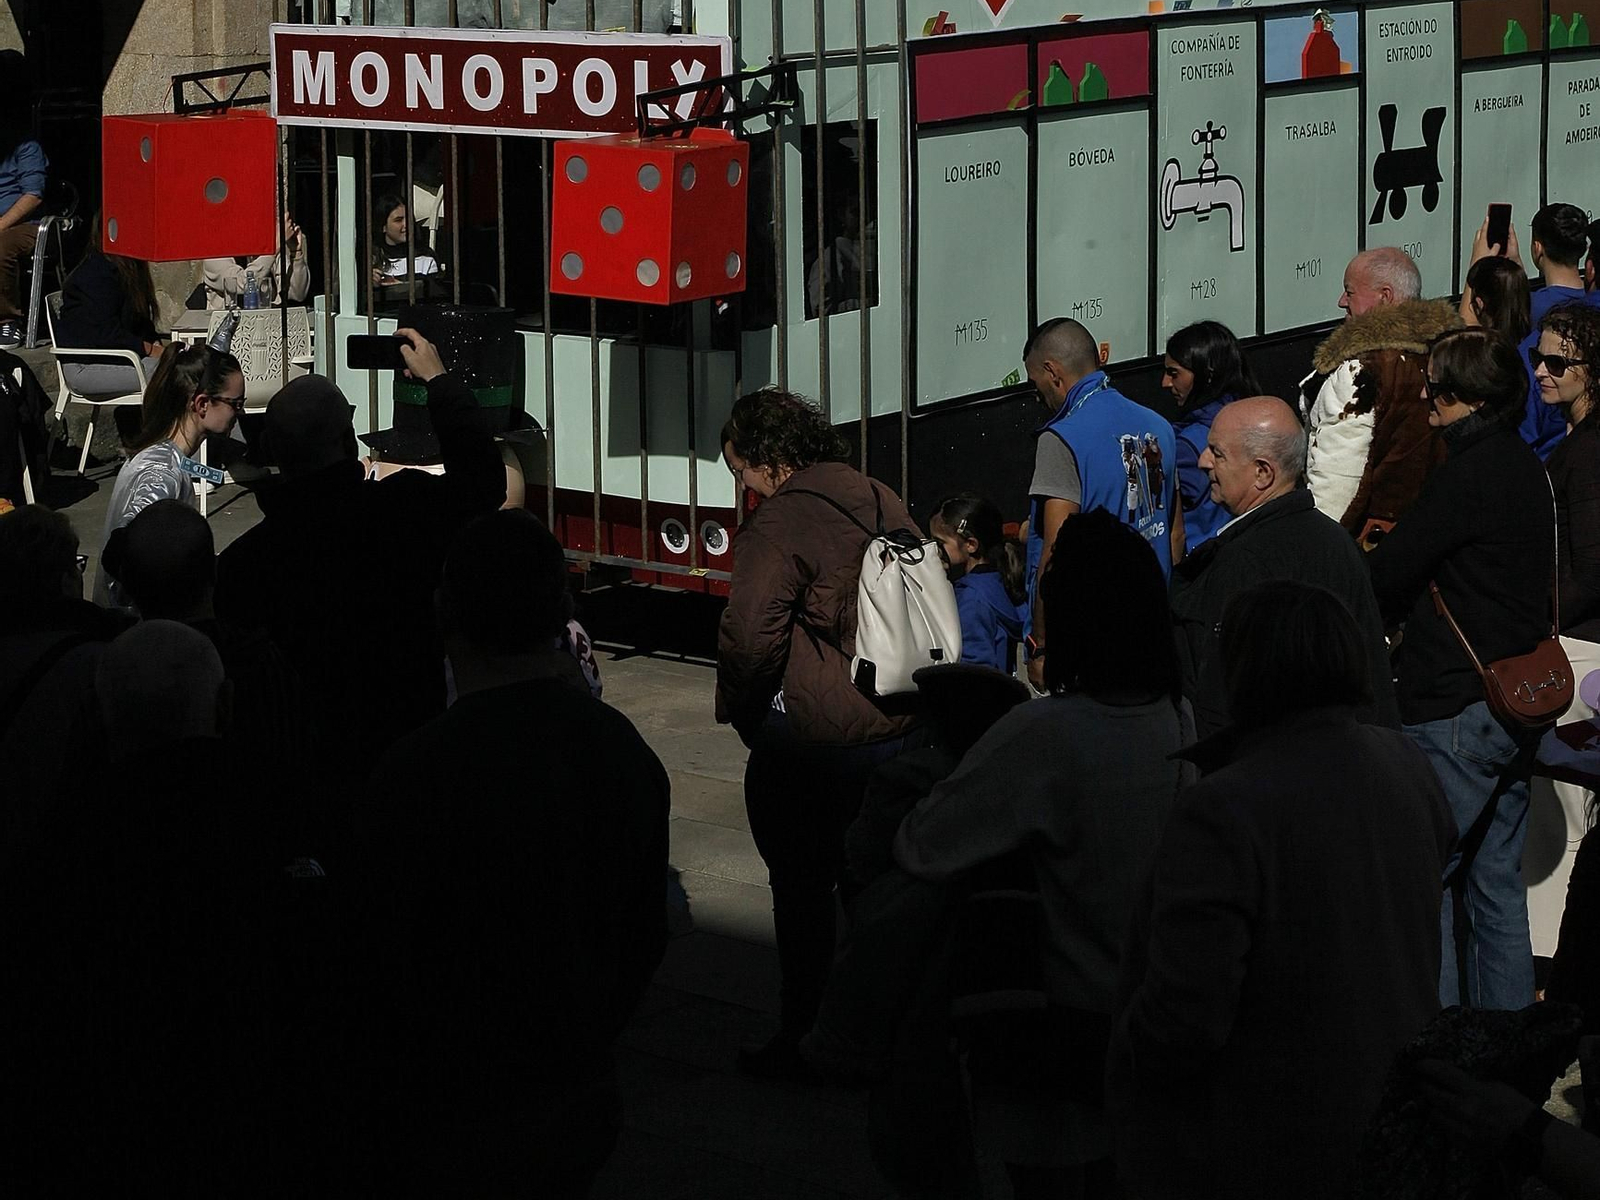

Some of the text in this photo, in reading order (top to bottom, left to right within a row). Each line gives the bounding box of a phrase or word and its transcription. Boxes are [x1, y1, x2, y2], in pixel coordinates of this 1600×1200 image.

[1379, 17, 1437, 38] ESTACIÓN DO
[1171, 32, 1240, 54] COMPAÑÍA DE
[1386, 44, 1433, 62] ENTROIDO
[1181, 58, 1235, 81] FONTEFRÍA
[292, 49, 707, 121] MONOPOLY
[1568, 77, 1600, 95] PARADA
[1474, 95, 1524, 112] A BERGUEIRA
[1579, 103, 1591, 118] DE
[1285, 120, 1337, 141] TRASALBA
[1068, 147, 1116, 167] BÓVEDA
[945, 160, 1001, 183] LOUREIRO
